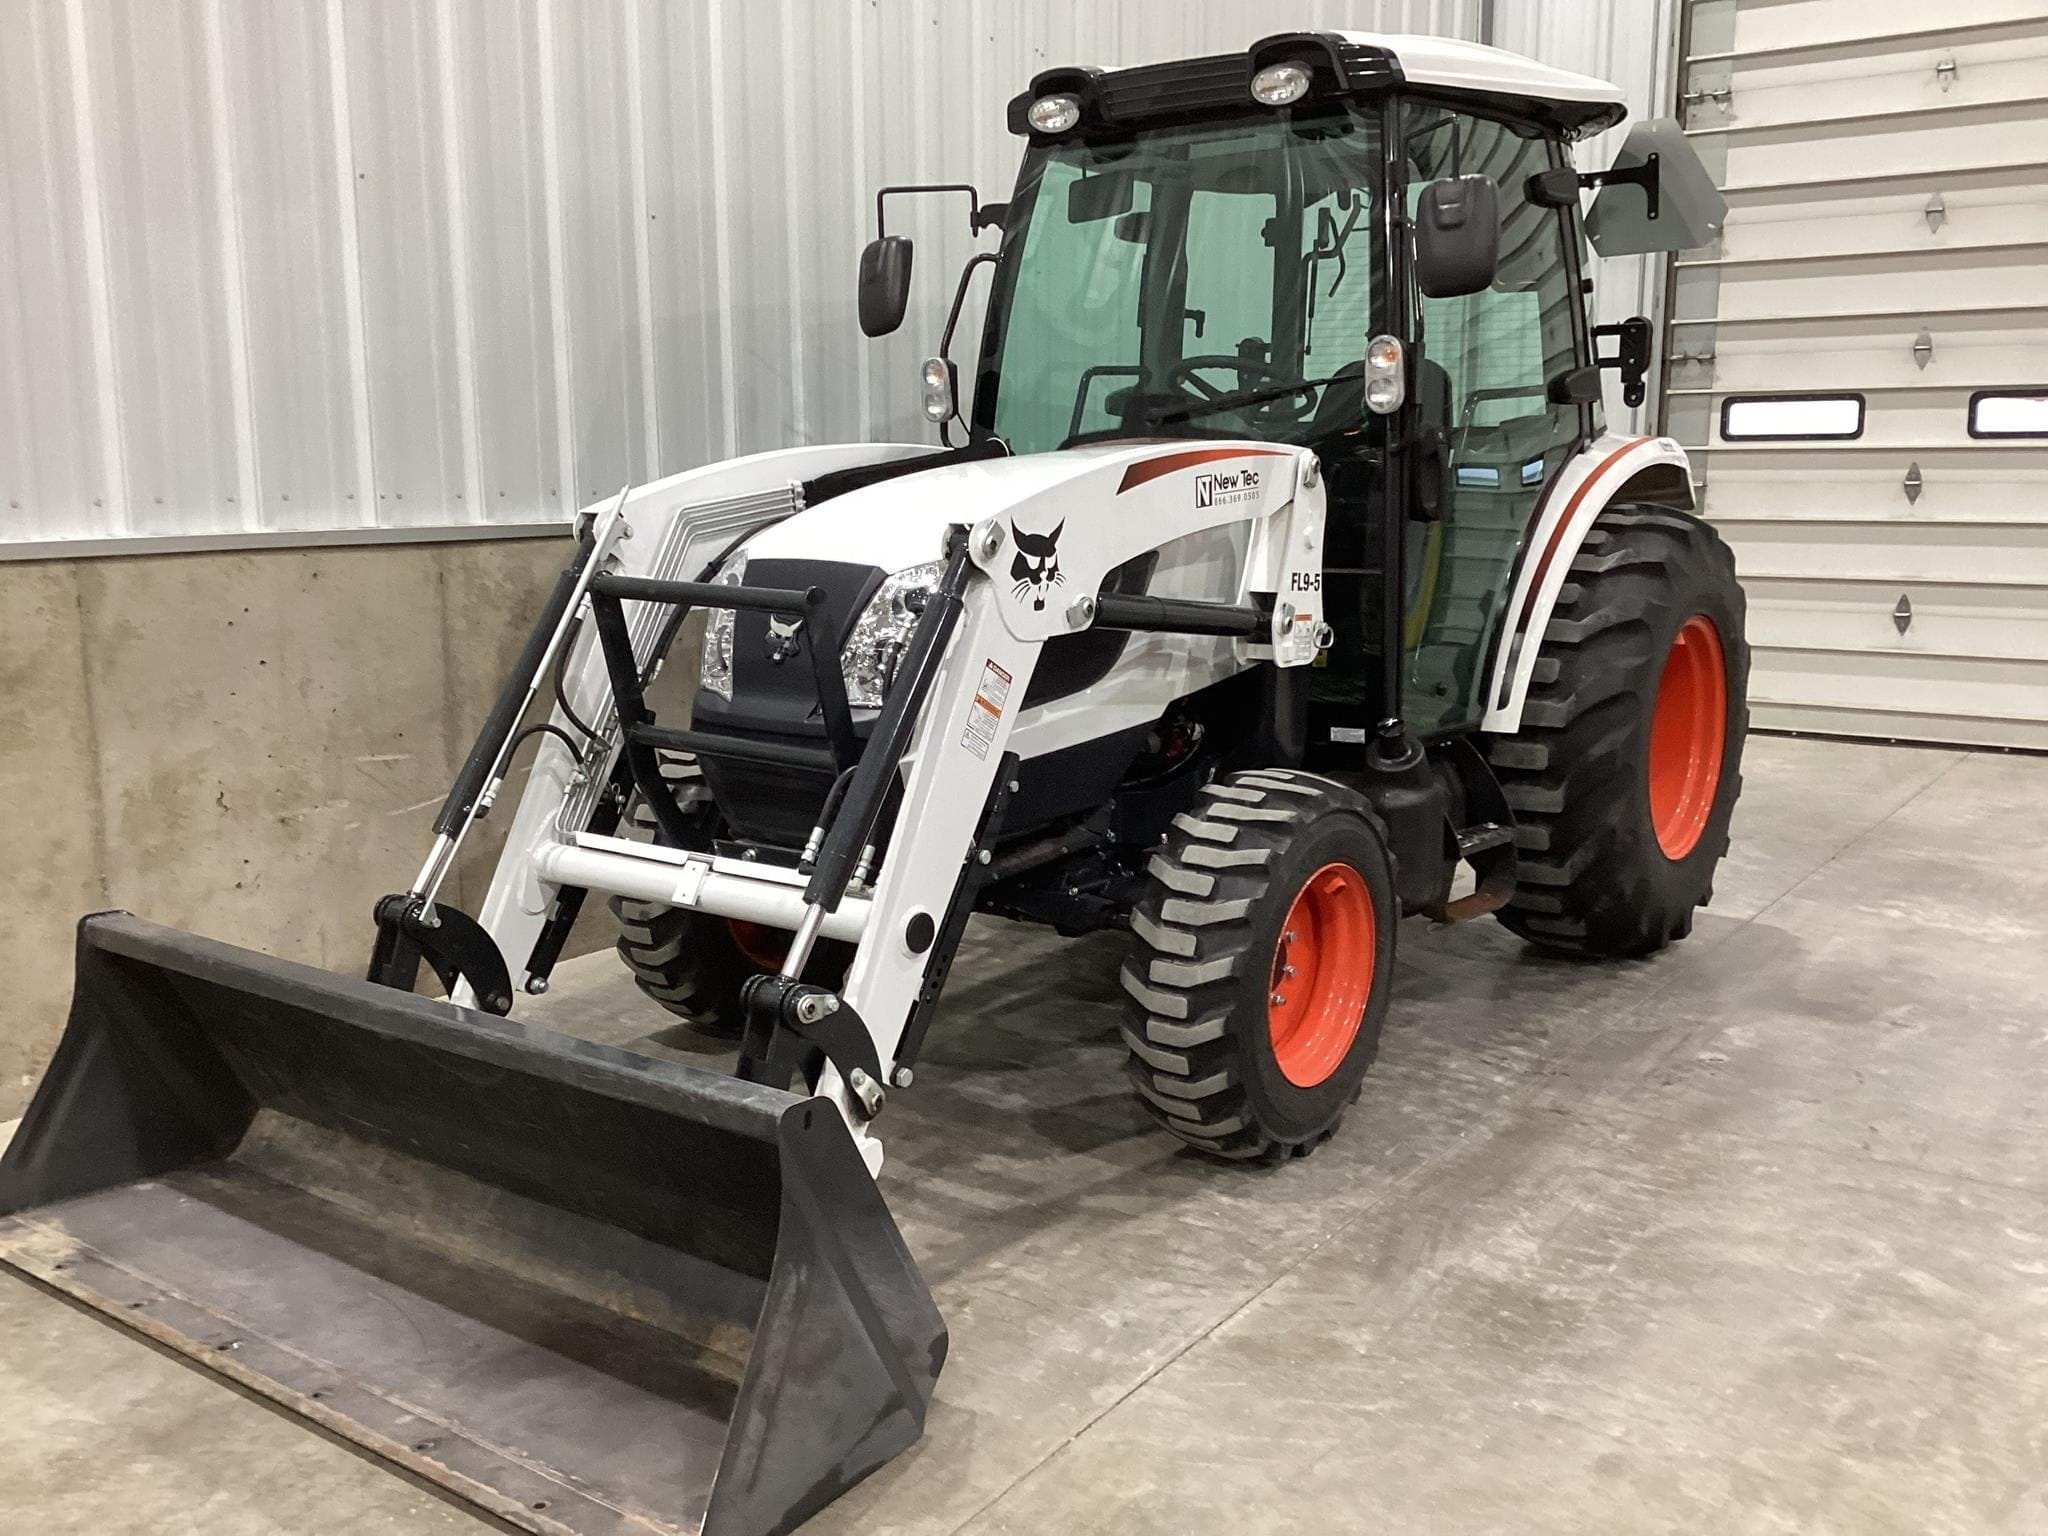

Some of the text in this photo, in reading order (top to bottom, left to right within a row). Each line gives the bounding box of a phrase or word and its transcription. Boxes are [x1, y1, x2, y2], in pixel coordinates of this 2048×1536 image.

[1214, 470, 1259, 491] New Tec
[1291, 572, 1321, 592] FL9-5
